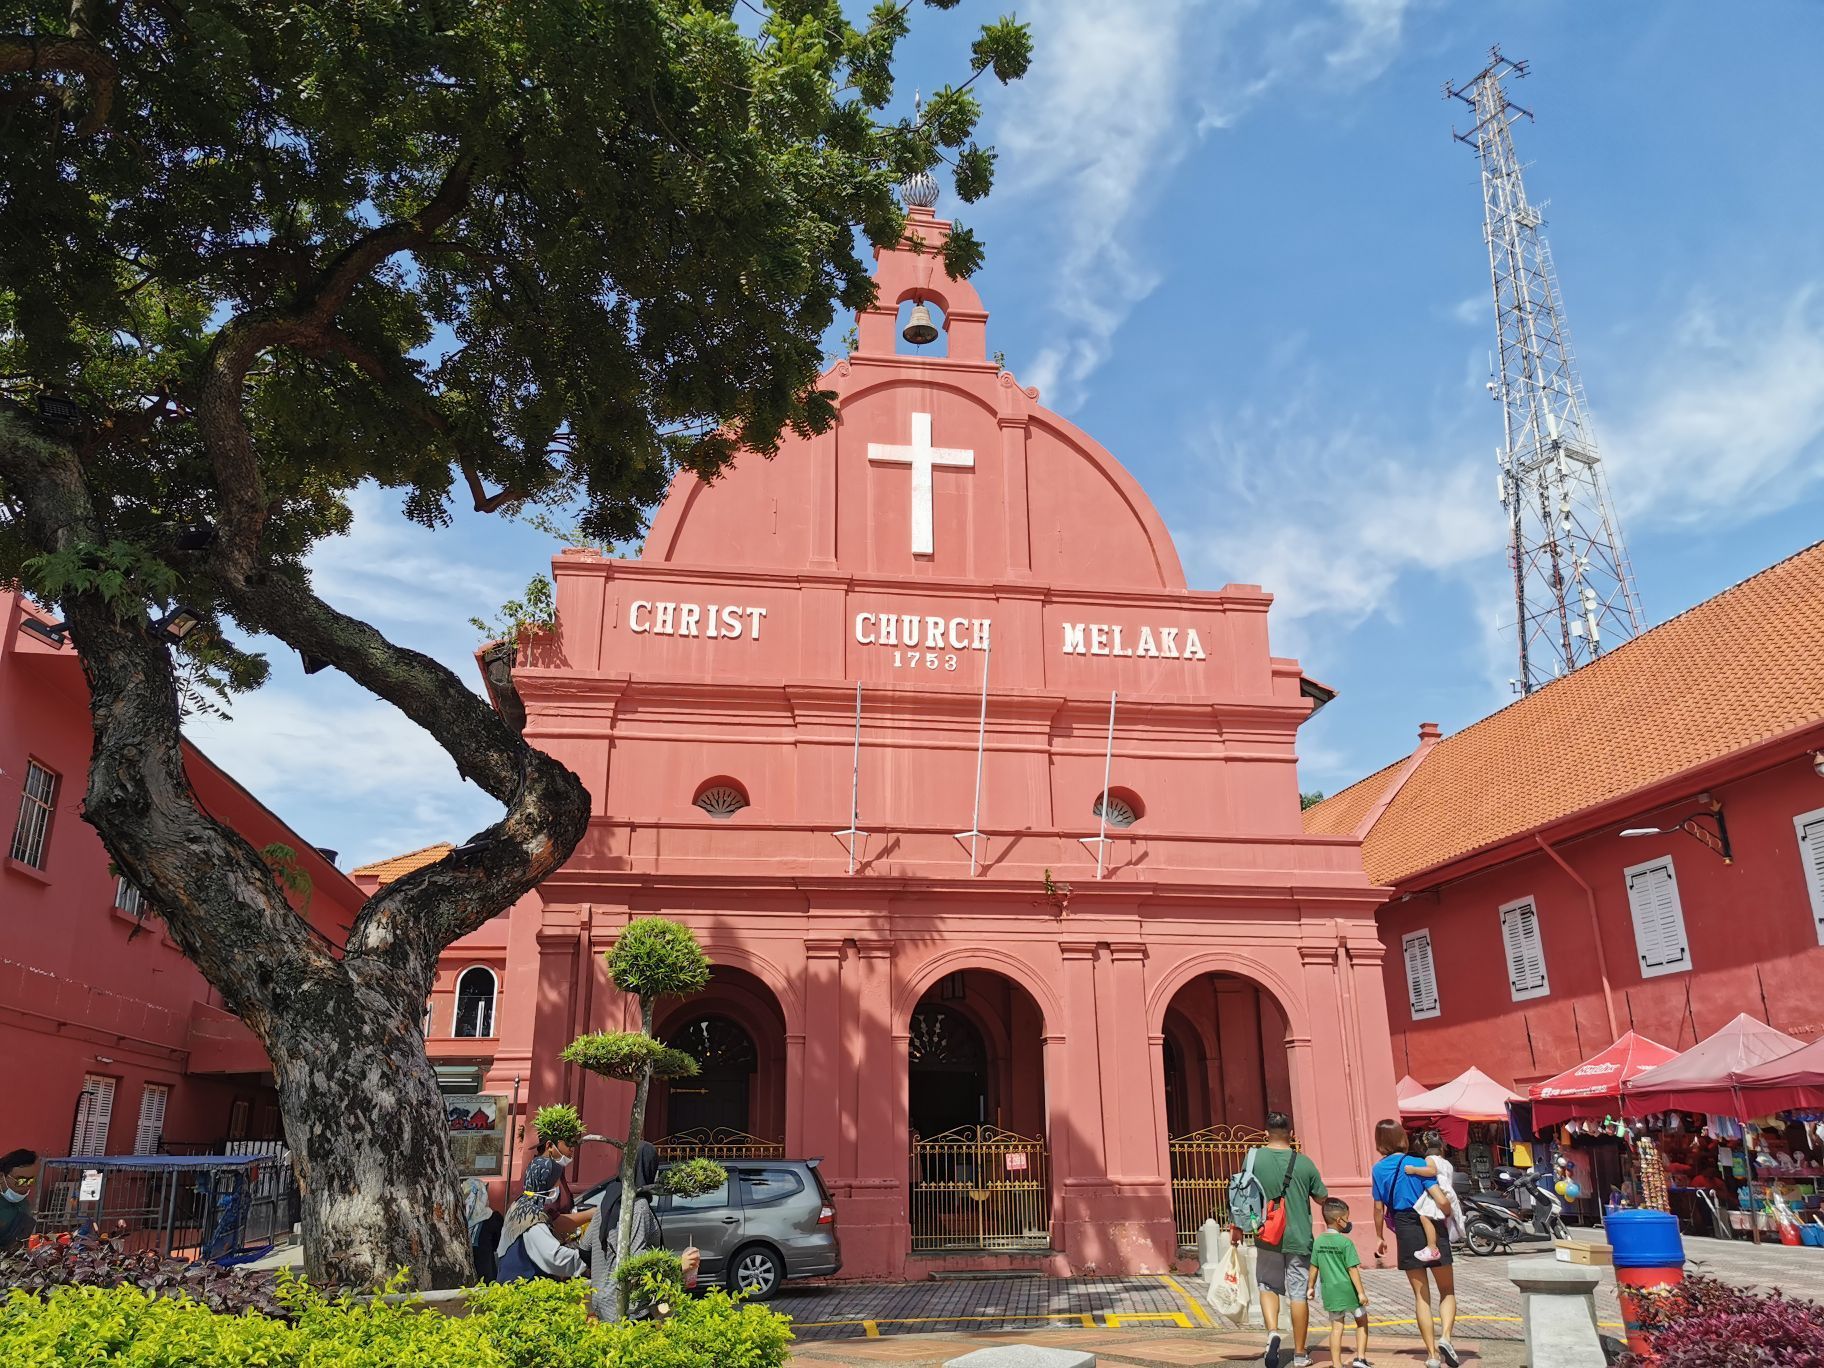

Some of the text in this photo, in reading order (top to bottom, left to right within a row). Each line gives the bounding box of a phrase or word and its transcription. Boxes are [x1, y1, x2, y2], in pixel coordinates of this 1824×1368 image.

[629, 600, 1206, 659] CHRIST CHURCH MELAKA
[893, 651, 957, 671] 1753
